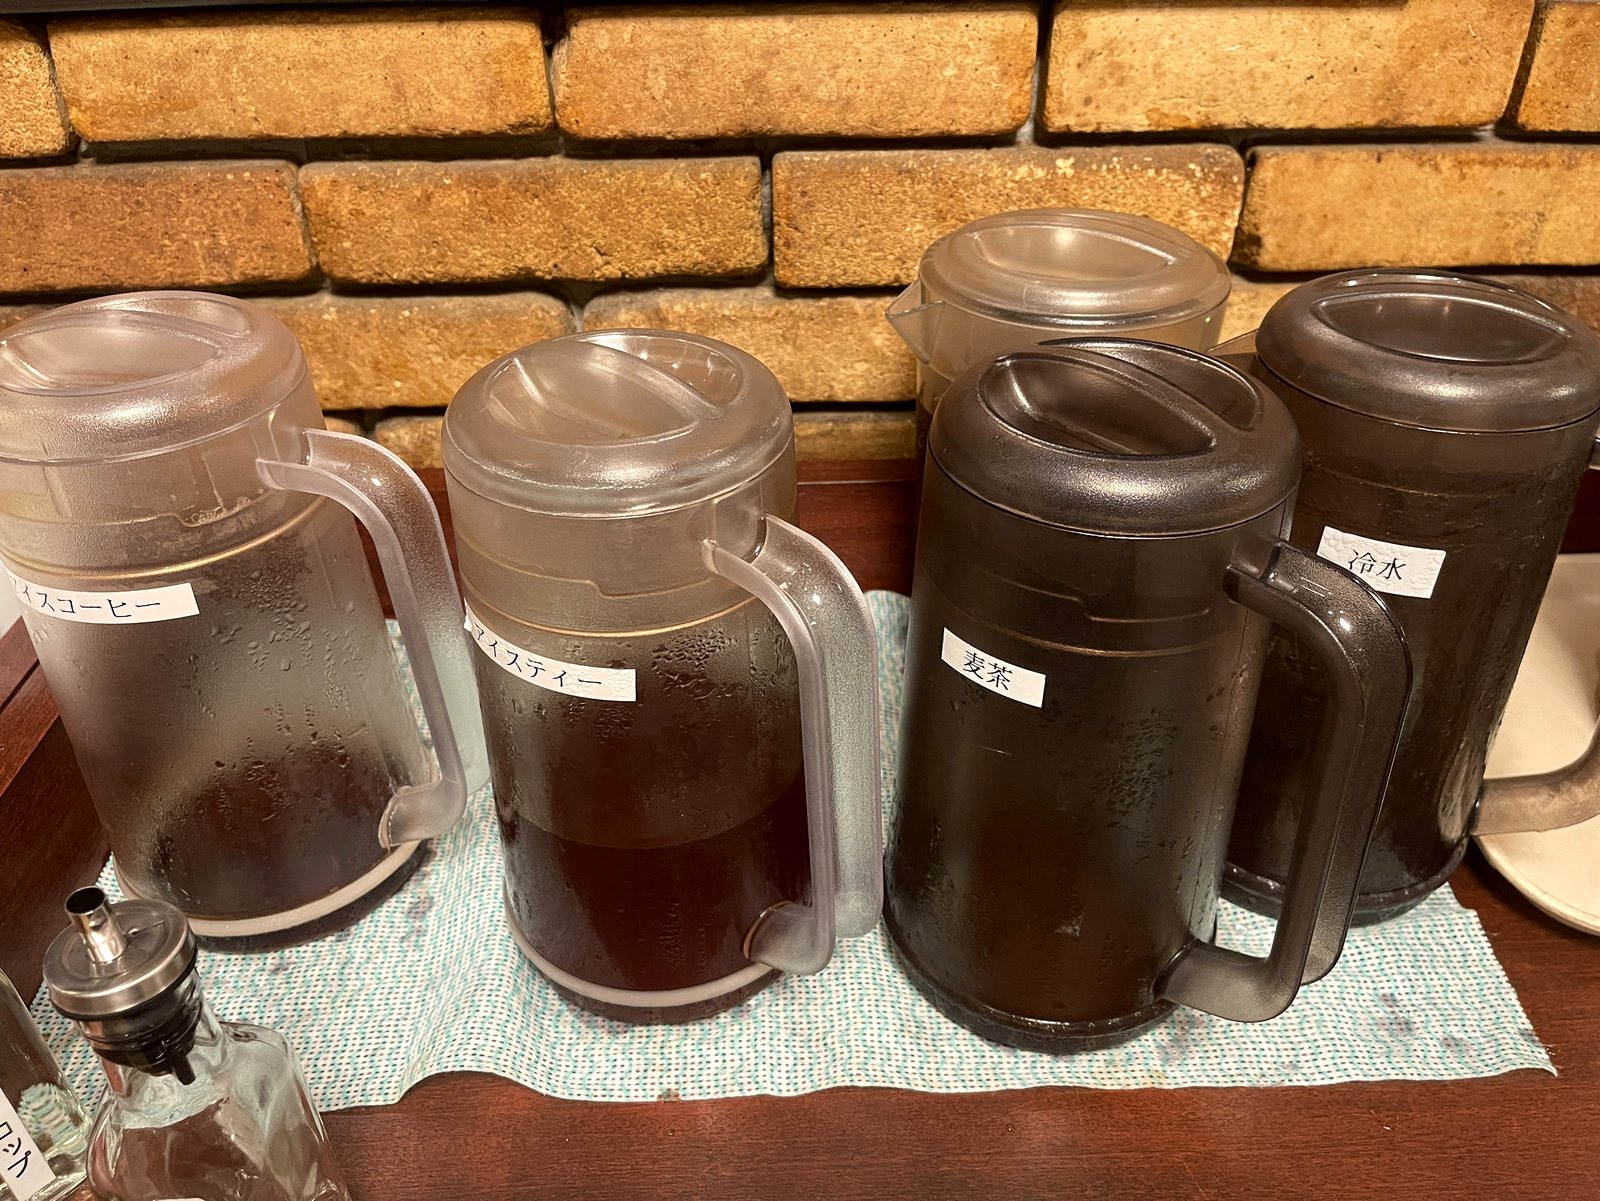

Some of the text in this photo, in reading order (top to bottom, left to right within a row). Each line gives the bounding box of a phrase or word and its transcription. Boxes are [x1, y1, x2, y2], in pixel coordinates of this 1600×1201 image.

[1348, 549, 1406, 580] 冷水
[474, 623, 602, 687] アイスティー
[963, 650, 1013, 691] 麦茶
